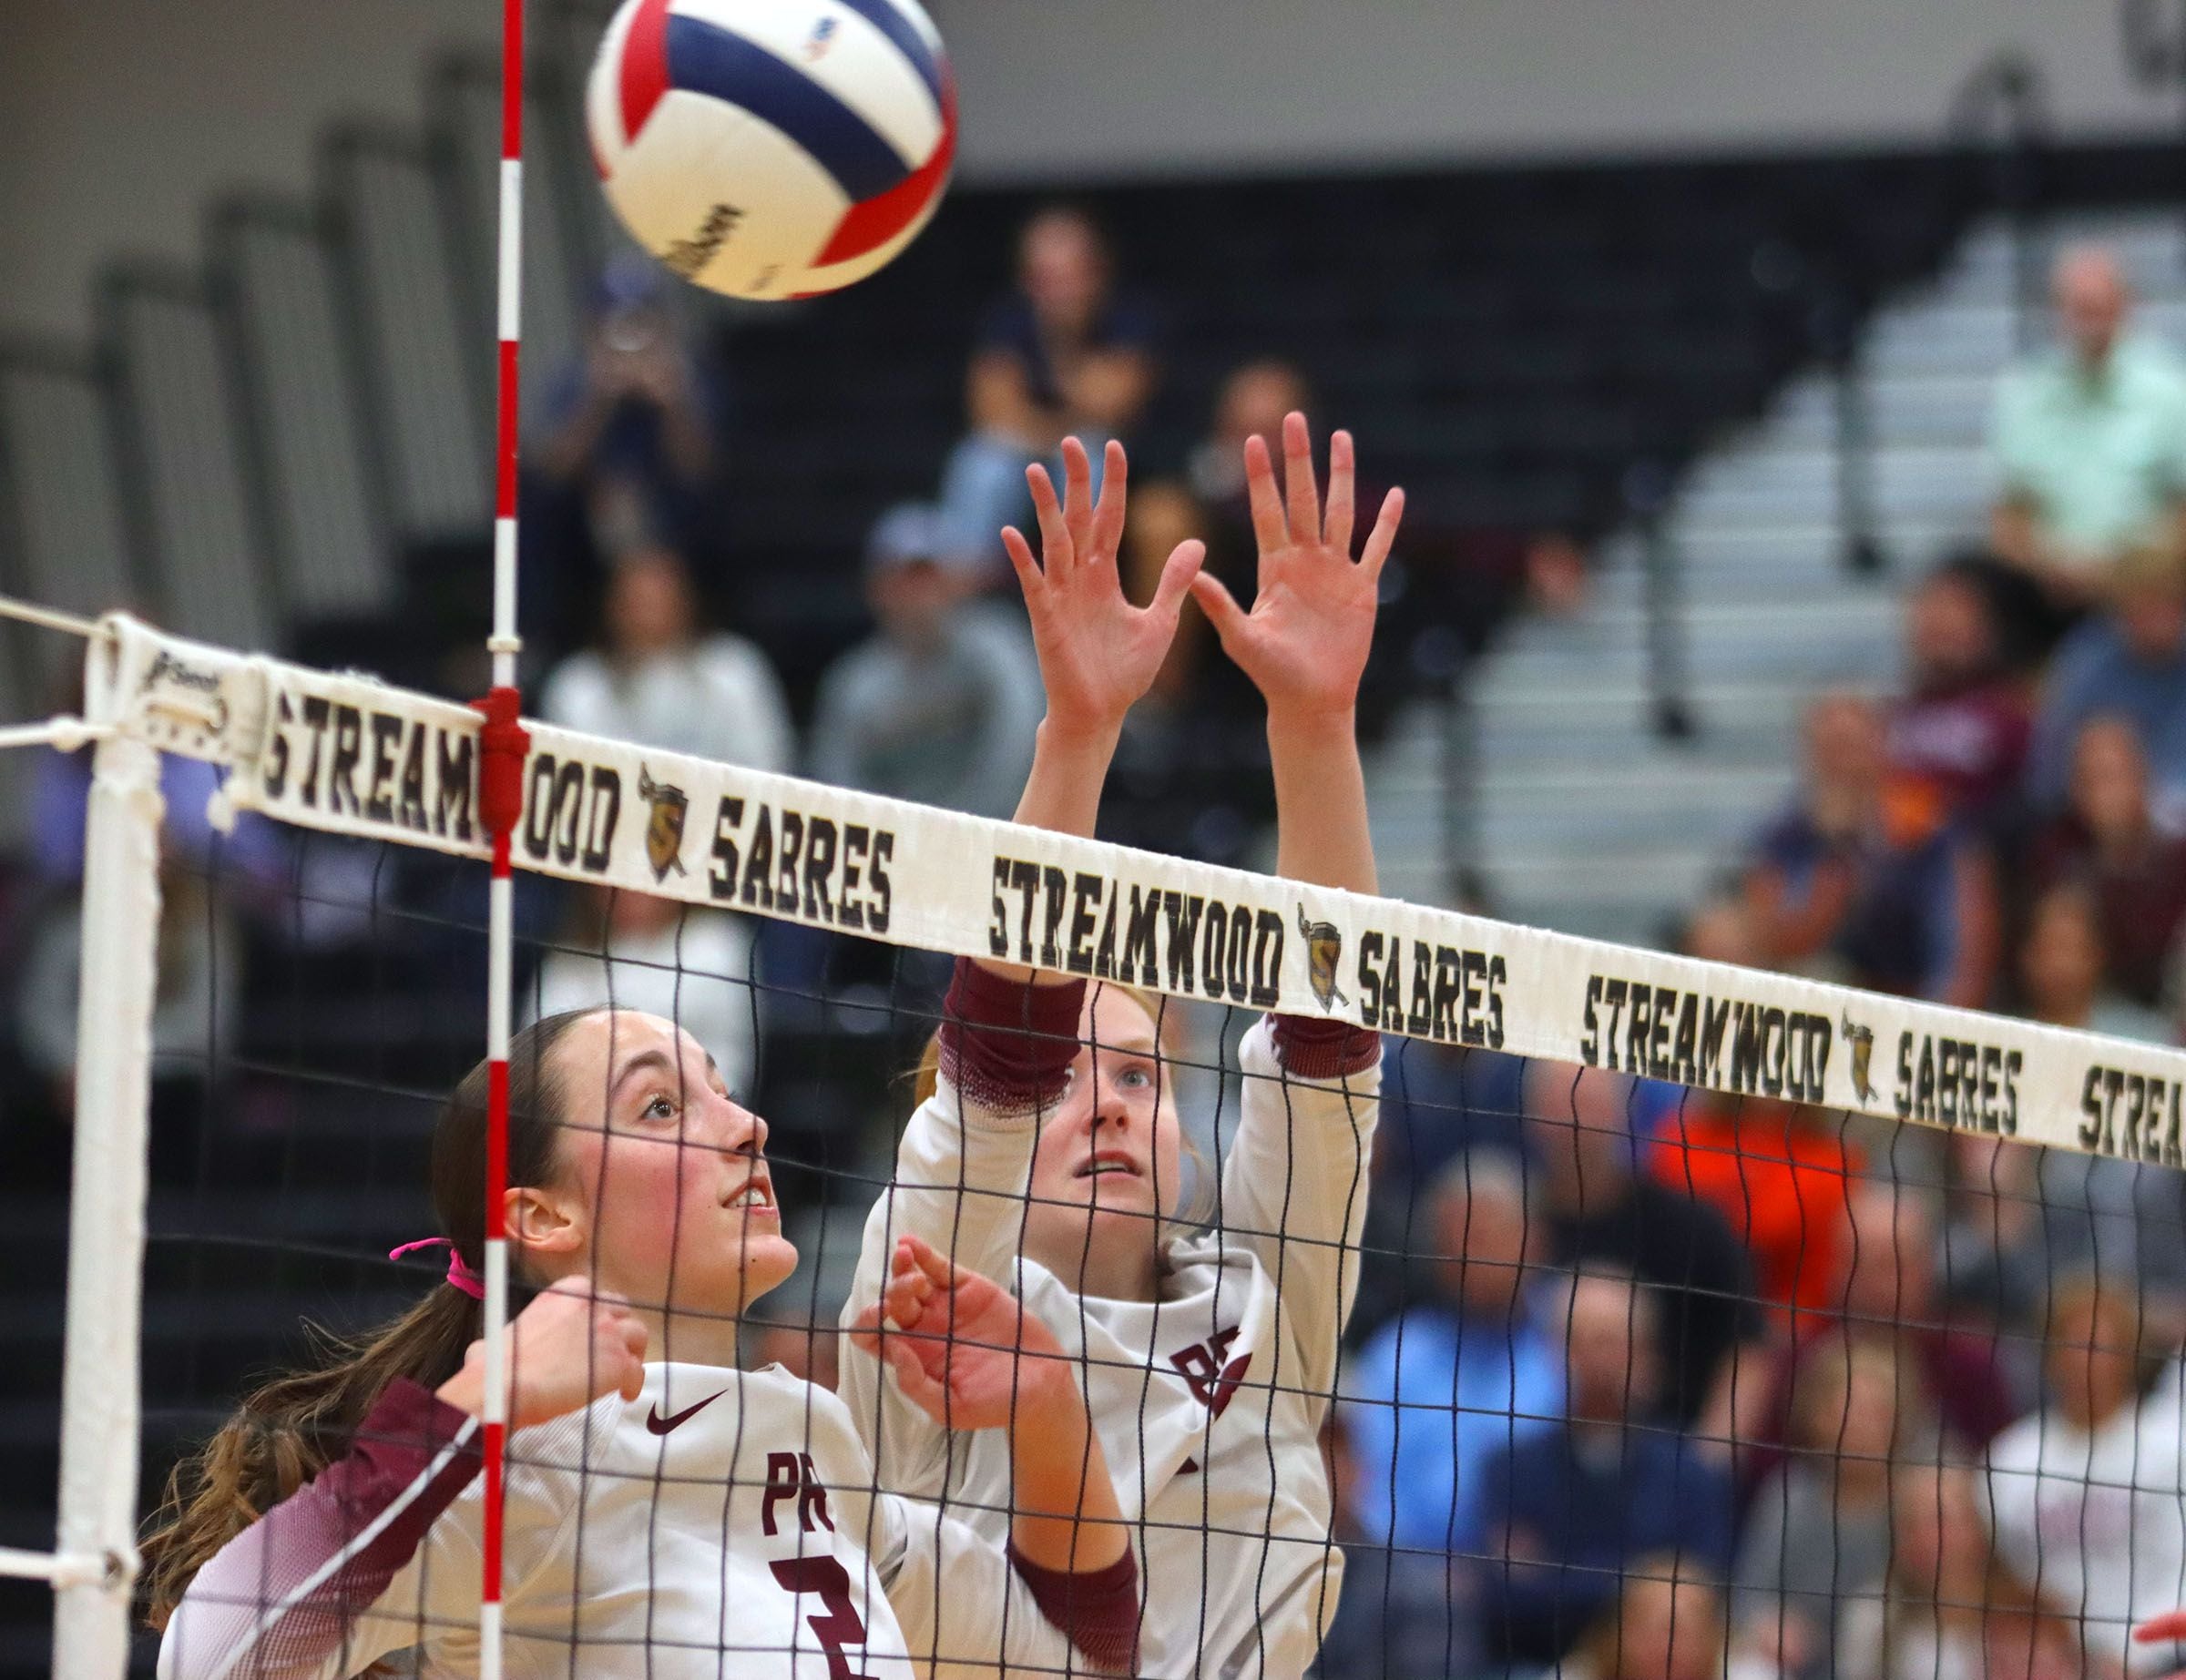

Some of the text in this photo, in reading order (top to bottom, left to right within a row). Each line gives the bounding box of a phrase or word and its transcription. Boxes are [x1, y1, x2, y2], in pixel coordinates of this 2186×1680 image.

[264, 689, 895, 933] STREAMOOD SABRES
[988, 856, 1507, 1050] STREAMWOOD SABRES
[1580, 975, 2022, 1135] STREAMWOOD SABRES
